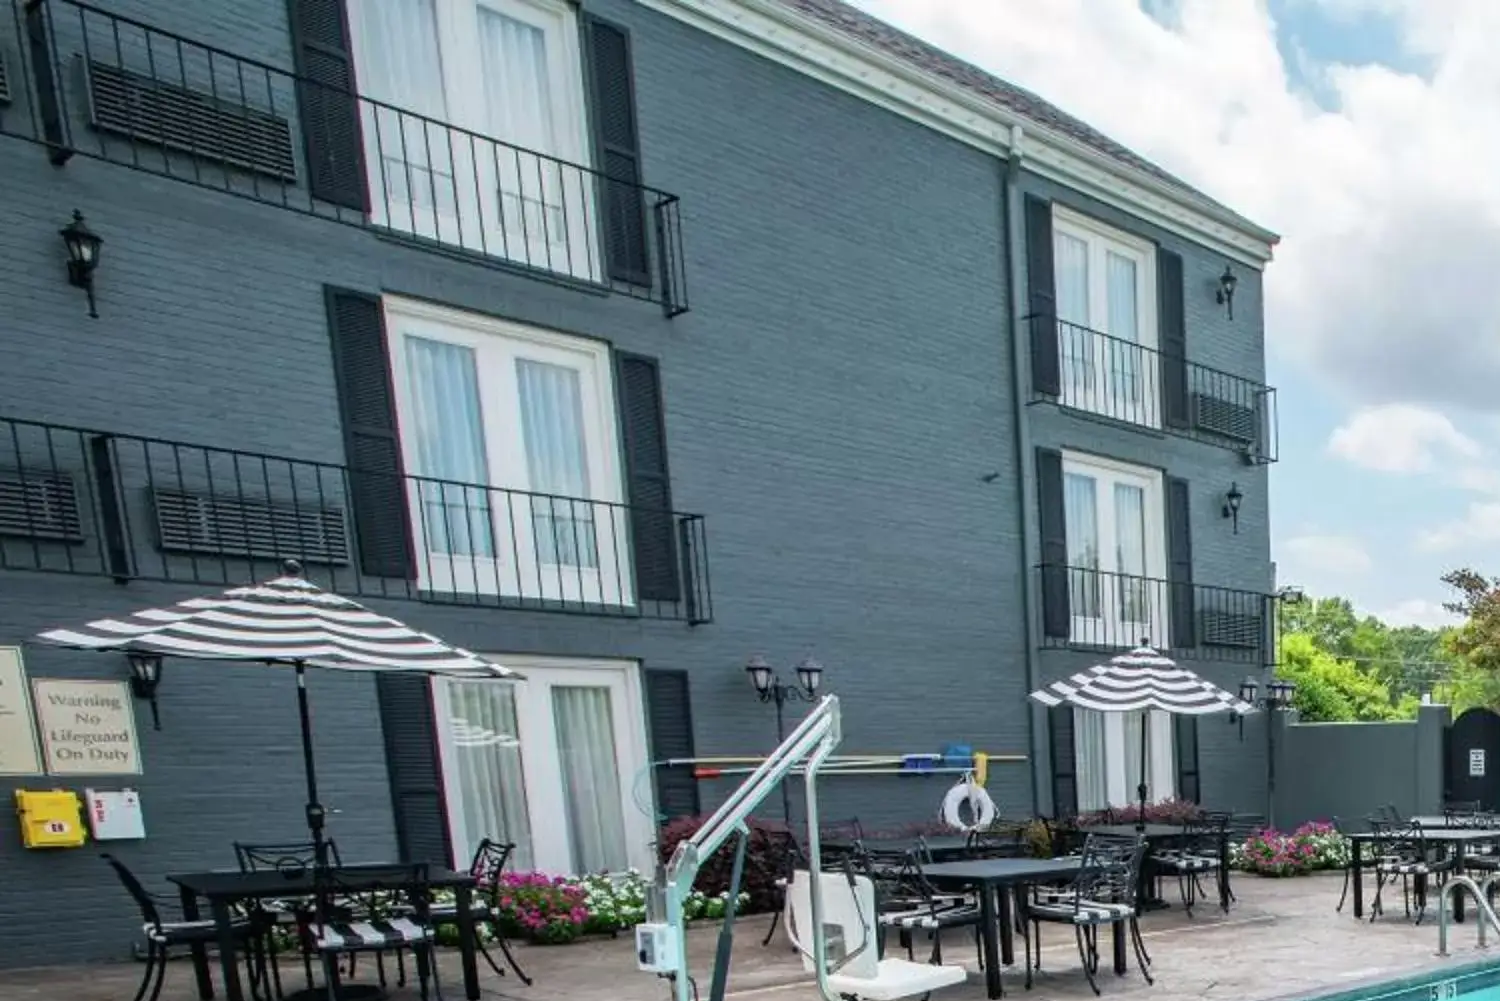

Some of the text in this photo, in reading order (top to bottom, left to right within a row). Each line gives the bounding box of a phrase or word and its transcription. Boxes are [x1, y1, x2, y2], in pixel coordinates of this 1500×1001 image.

[47, 692, 121, 711] Warning
[75, 712, 101, 725] No
[51, 729, 128, 747] Lifeguard
[56, 748, 129, 763] On Duty
